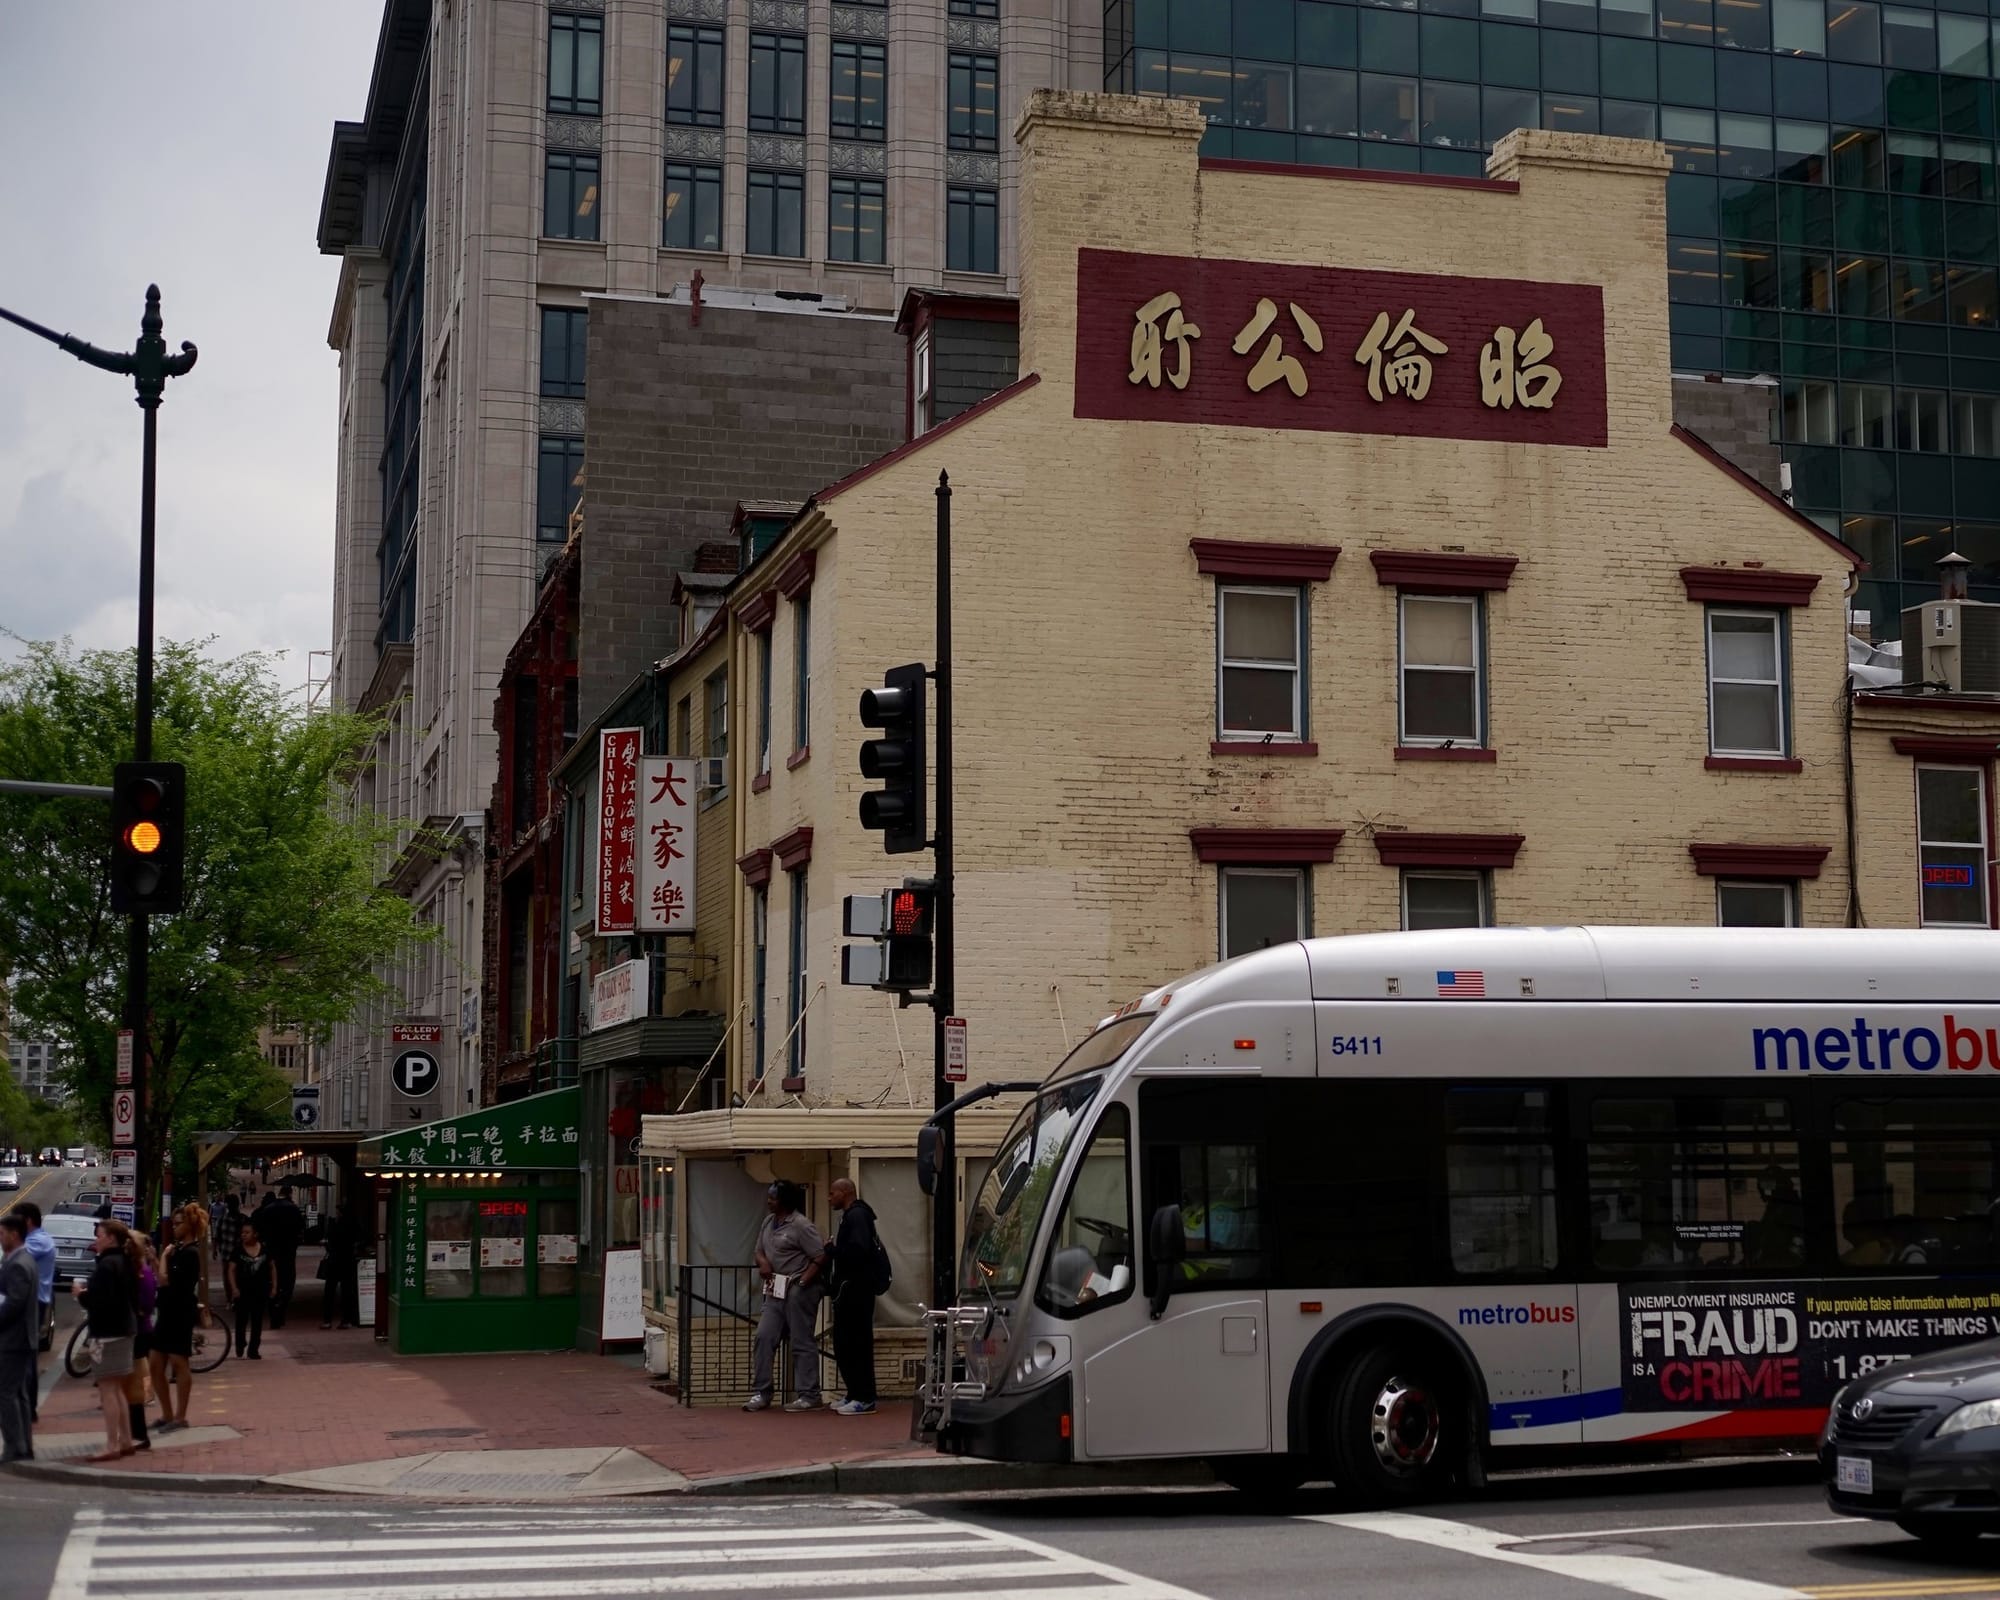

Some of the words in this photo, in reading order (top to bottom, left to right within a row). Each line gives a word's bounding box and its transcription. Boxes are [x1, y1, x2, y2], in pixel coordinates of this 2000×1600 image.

[603, 735, 617, 840] CHINATOWN
[649, 762, 687, 924] 大家樂
[602, 846, 613, 928] EXPRESS
[1331, 1037, 1382, 1056] 5411
[479, 1202, 528, 1217] OPEN
[1629, 1294, 1727, 1310] UNEMPLOYMENT
[1729, 1292, 1796, 1306] INSURANCE
[1816, 1299, 1833, 1313] you
[1834, 1297, 1868, 1313] provide
[1869, 1297, 1891, 1311] false
[1892, 1296, 1944, 1311] information
[1945, 1295, 1971, 1309] when
[1971, 1296, 1989, 1311] you
[1459, 1302, 1575, 1324] metrobus
[1632, 1307, 1798, 1358] FRAUD
[1809, 1319, 1861, 1340] DON'T
[1866, 1319, 1919, 1338] MAKE
[1925, 1317, 1987, 1337] THINGS
[1633, 1363, 1645, 1376] IS
[1646, 1363, 1655, 1376] A
[1660, 1357, 1800, 1402] CRIME
